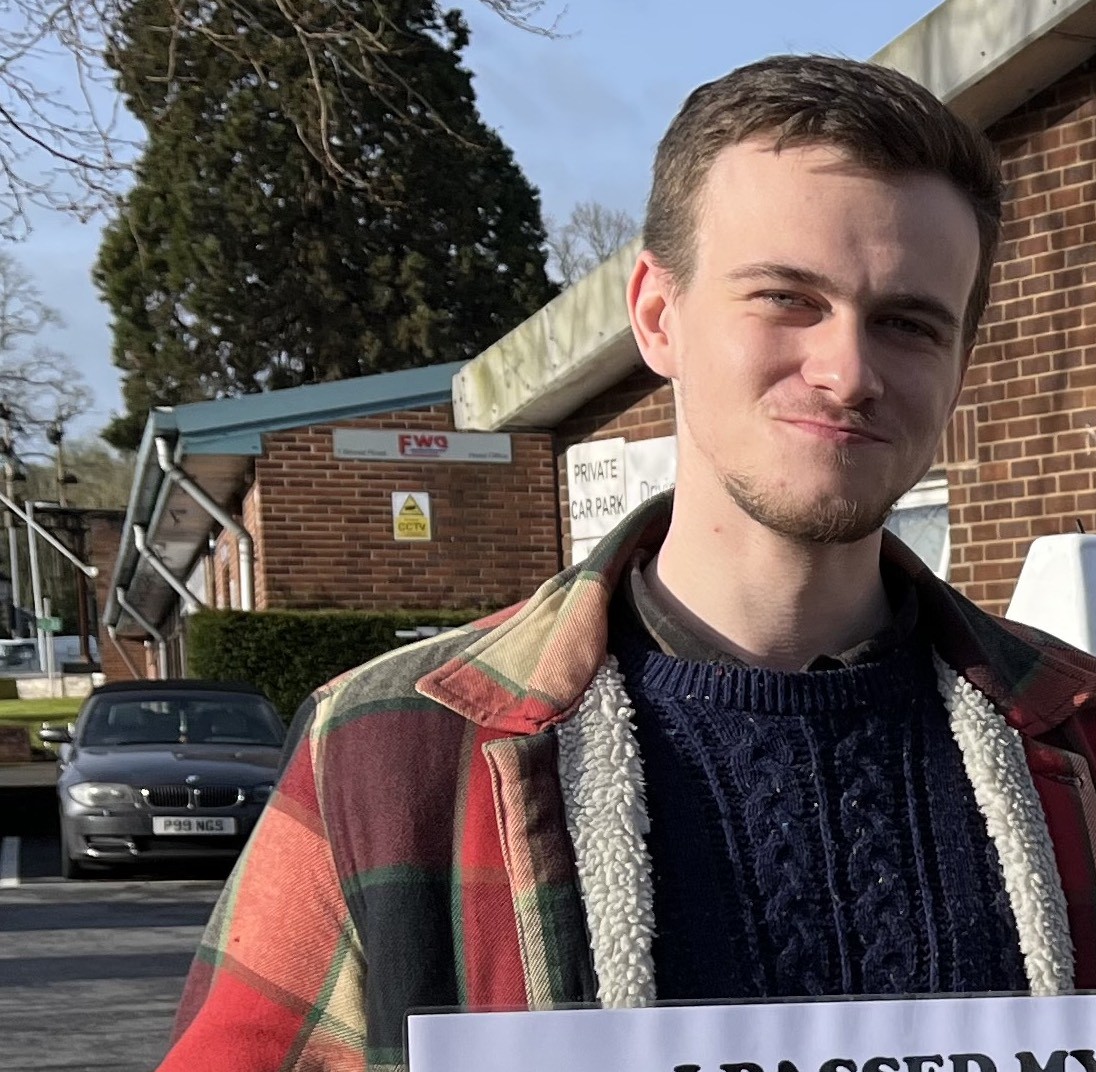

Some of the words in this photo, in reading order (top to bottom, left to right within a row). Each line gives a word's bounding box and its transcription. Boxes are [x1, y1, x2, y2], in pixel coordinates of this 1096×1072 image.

[573, 459, 618, 482] PRIVATE
[571, 499, 593, 520] CAR
[595, 494, 626, 517] PARK
[397, 522, 426, 531] CCTV
